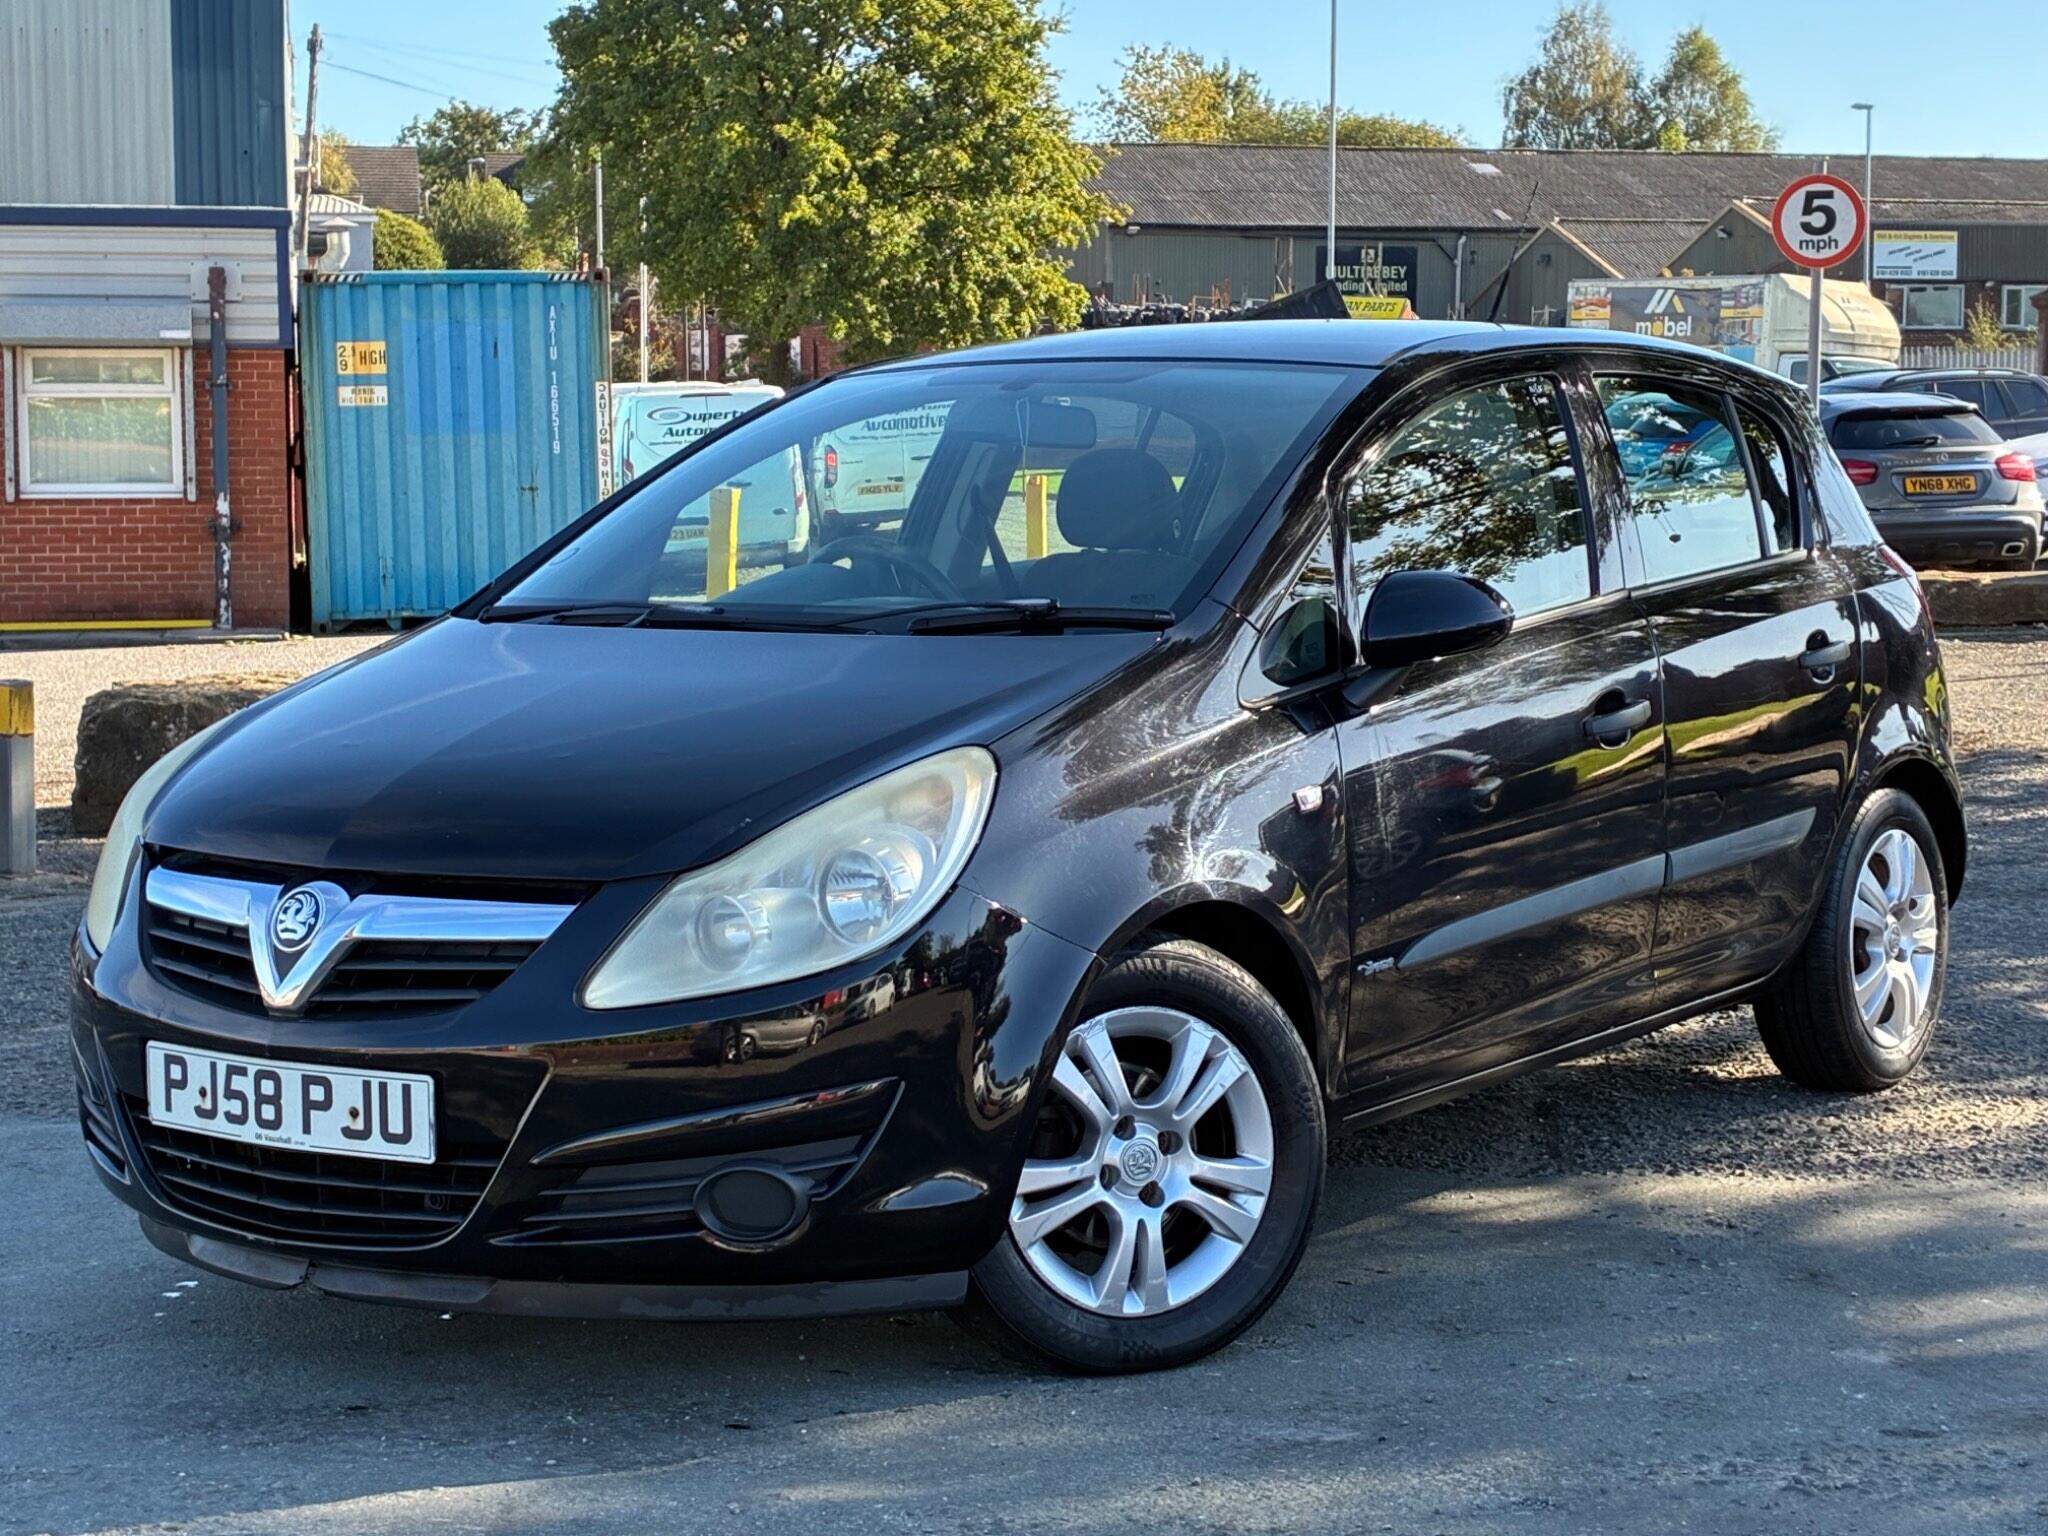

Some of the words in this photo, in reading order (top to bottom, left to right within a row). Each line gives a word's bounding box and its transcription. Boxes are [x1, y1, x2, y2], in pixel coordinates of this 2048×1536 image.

[1799, 190, 1837, 236] 5
[1799, 235, 1839, 253] mph
[1345, 301, 1361, 312] AN
[1362, 302, 1398, 312] PARTS
[549, 305, 558, 360] AXIU
[1635, 315, 1692, 337] möbel
[1910, 478, 1944, 491] YN68
[1946, 478, 1971, 490] XHG
[163, 1053, 283, 1131] PJ58
[301, 1073, 413, 1145] PJU
